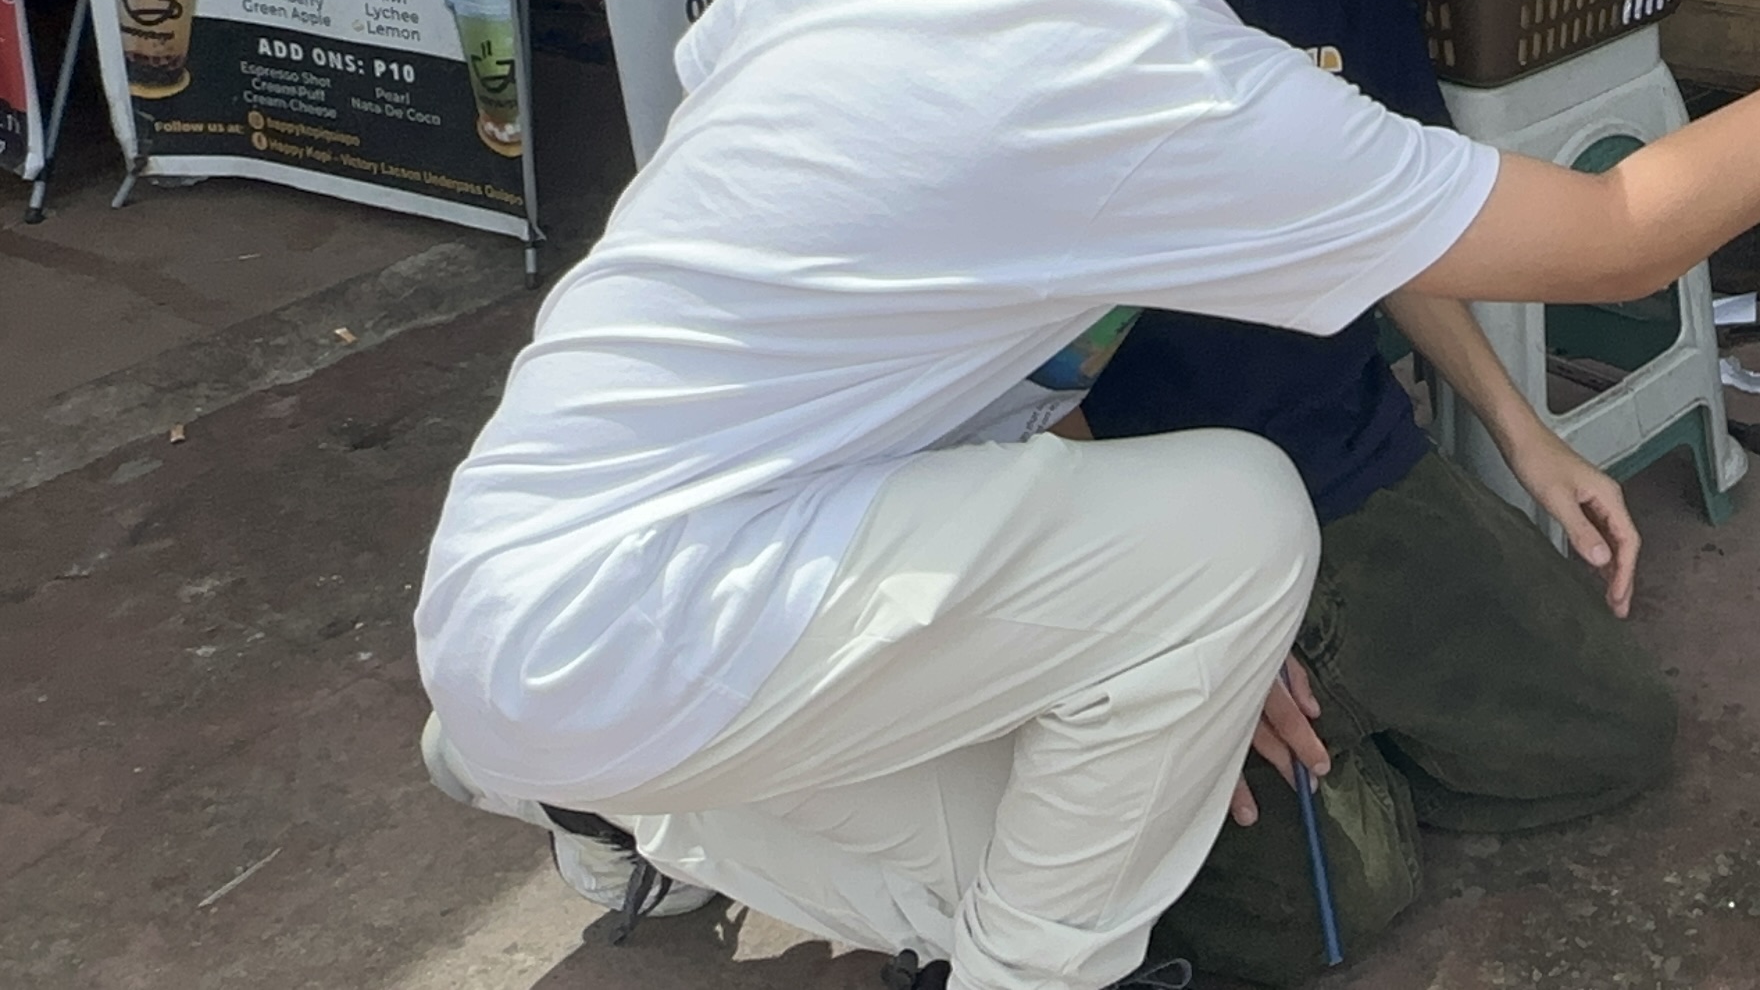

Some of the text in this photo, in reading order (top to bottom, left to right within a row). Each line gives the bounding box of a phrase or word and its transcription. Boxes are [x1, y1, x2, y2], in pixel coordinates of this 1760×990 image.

[242, 0, 332, 28] Green Apple
[364, 3, 420, 24] Lychee
[366, 20, 421, 42] Lemon
[258, 37, 416, 84] ADD ONS: P10
[375, 87, 411, 106] Pearl
[154, 120, 204, 134] Follow
